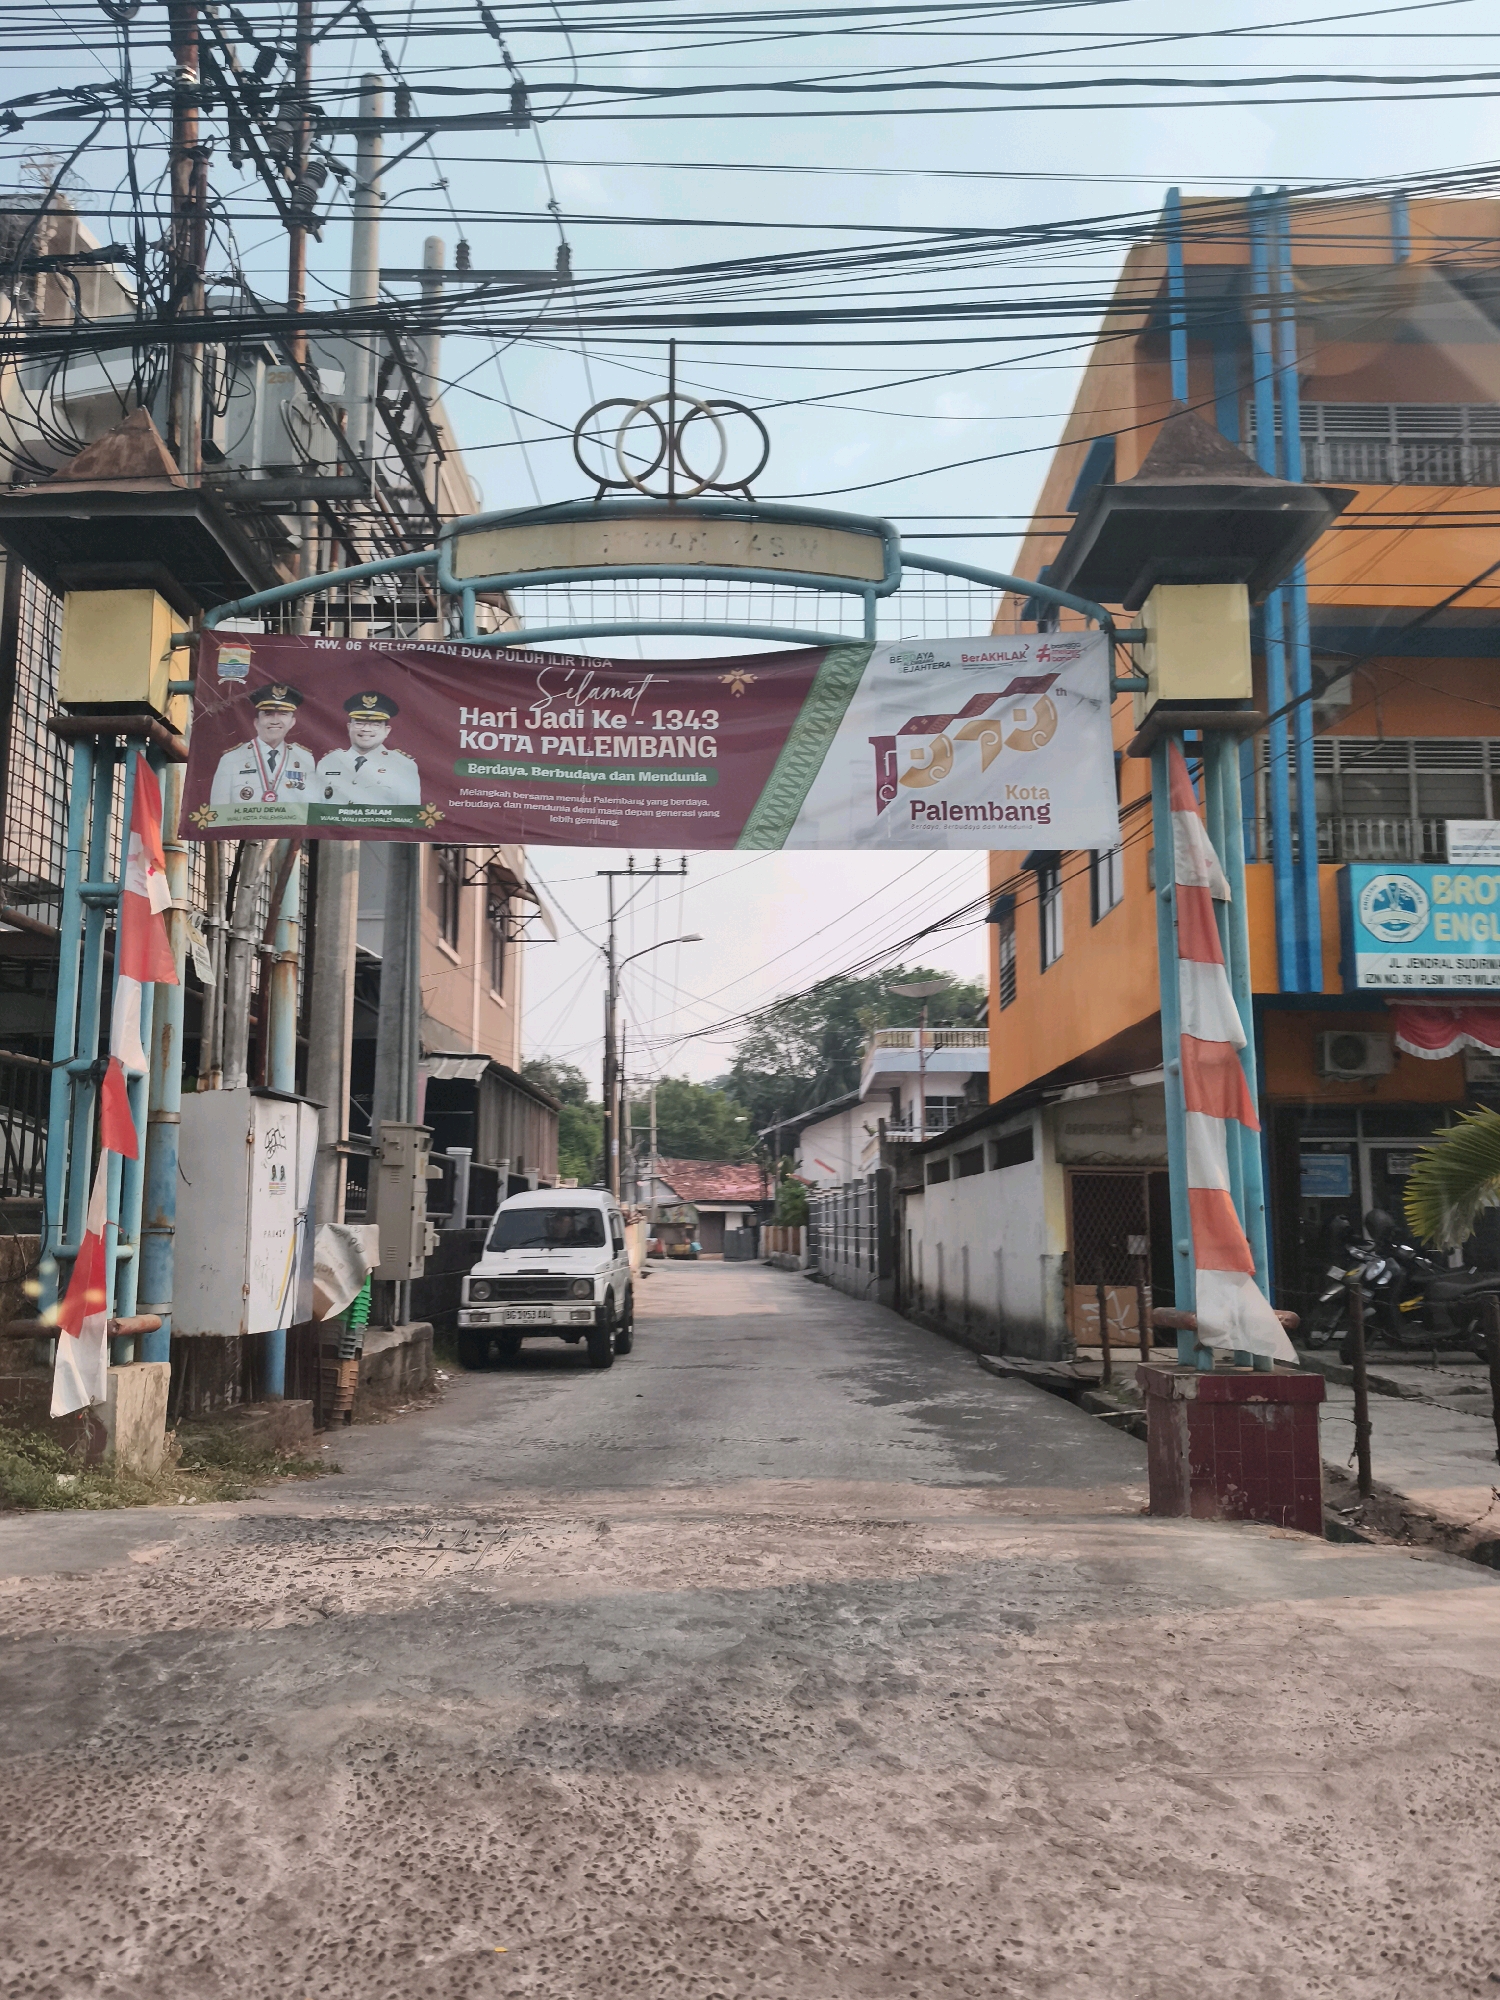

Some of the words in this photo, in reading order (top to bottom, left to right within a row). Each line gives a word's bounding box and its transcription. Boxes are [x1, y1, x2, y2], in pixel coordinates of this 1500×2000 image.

[314, 639, 341, 650] RW.
[345, 641, 362, 650] 06
[368, 642, 457, 656] KELURAHAN
[461, 646, 493, 660] DUA
[496, 650, 545, 664] PULUH
[548, 654, 576, 666] ILIR
[580, 656, 613, 668] TIGA
[961, 650, 1027, 663] BerAKHLAK
[528, 666, 670, 717] Selamat
[1055, 687, 1068, 698] th
[459, 706, 518, 729] Hari
[524, 707, 585, 730] Jadi
[591, 709, 628, 730] Ke
[651, 709, 720, 730] 1343
[459, 729, 534, 754] KOTA
[540, 736, 718, 758] PALEMBANG
[467, 763, 529, 777] Berdaya,
[531, 766, 607, 782] Berbudaya
[609, 770, 636, 782] dan
[638, 771, 708, 782] Mendunia
[459, 788, 512, 798] Melangkah
[512, 791, 555, 801] bersama
[593, 796, 646, 806] Palembang
[646, 798, 669, 806] yang
[1005, 784, 1051, 800] Kota
[338, 808, 363, 816] PRIMA
[364, 808, 393, 816] SALAM
[503, 800, 522, 809] dan
[523, 803, 571, 813] mendunia
[624, 808, 654, 817] depan
[655, 809, 696, 818] generasi
[697, 810, 720, 818] yang
[910, 800, 1051, 825] Palembang
[549, 814, 574, 824] lebih
[1406, 957, 1454, 969] JENDRAL
